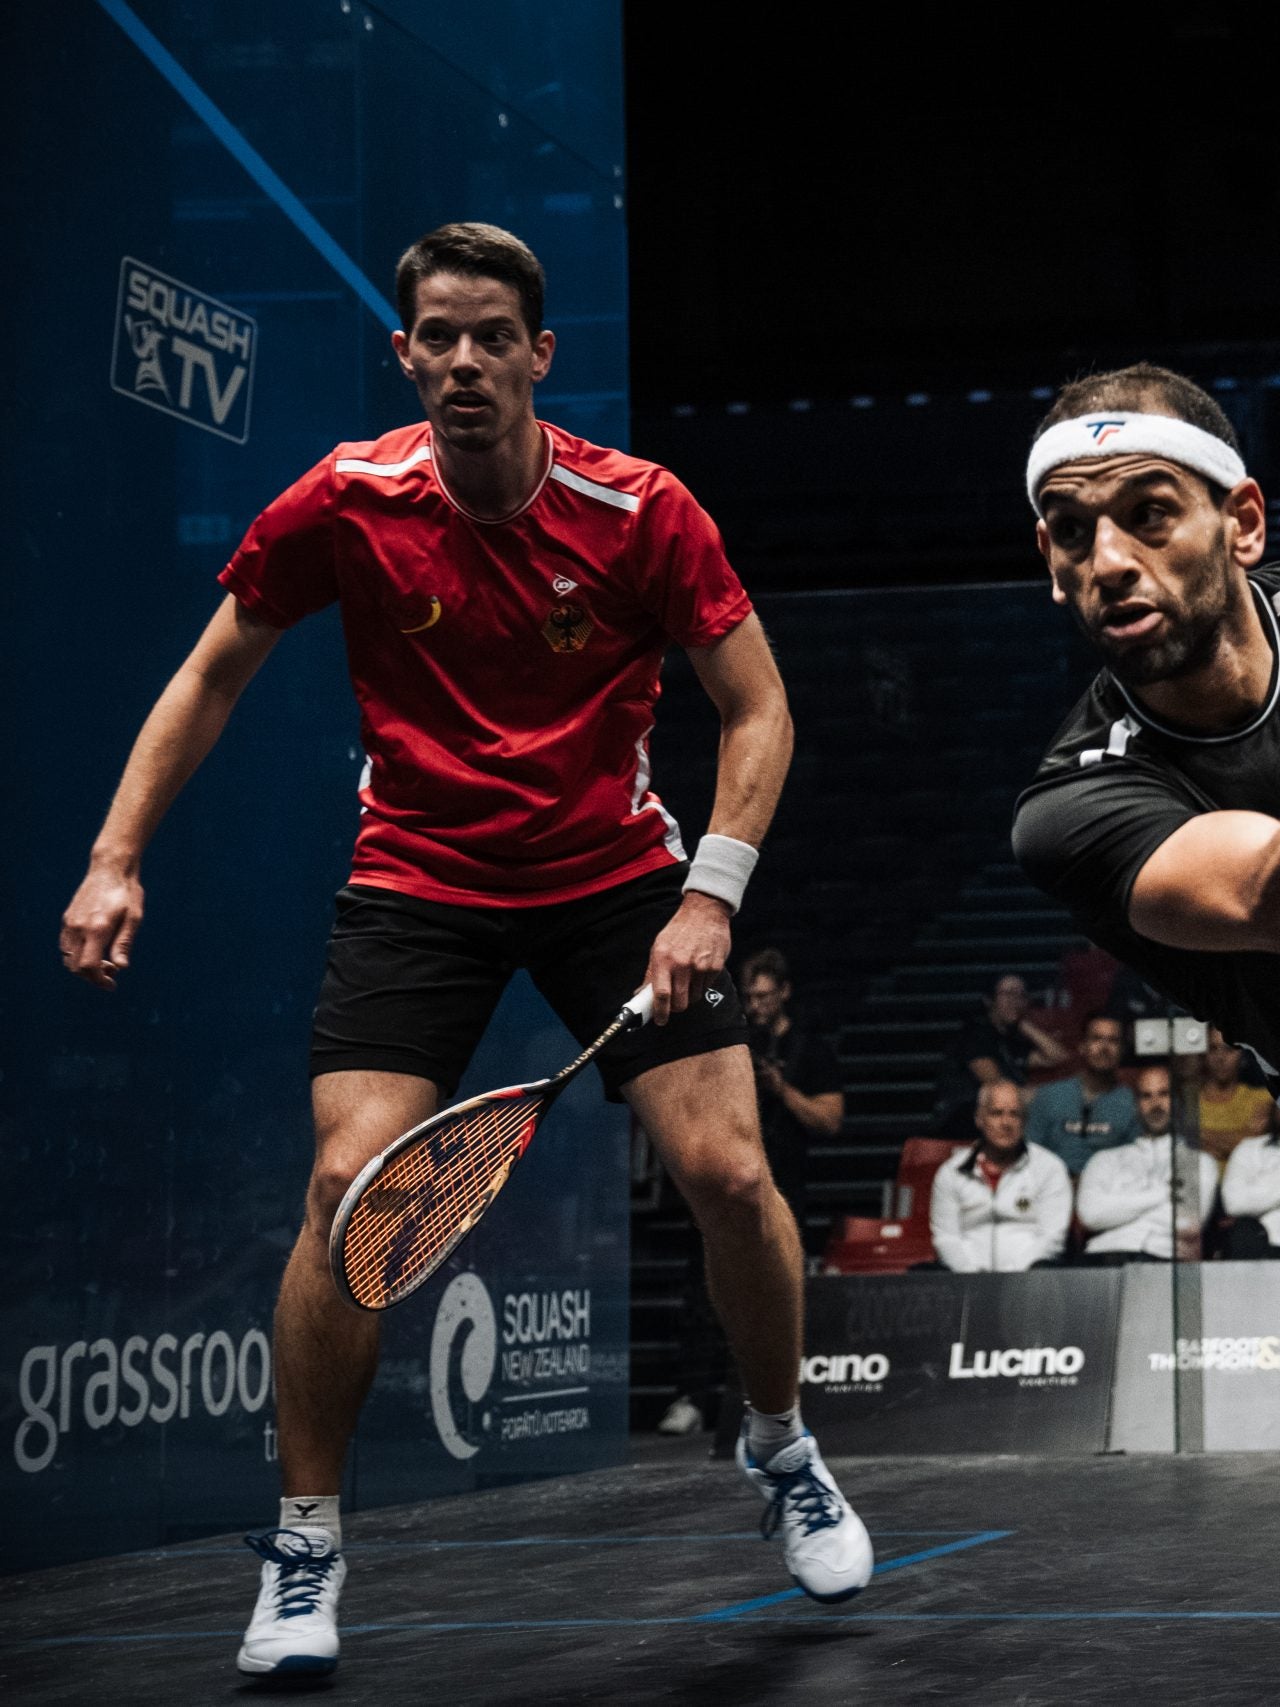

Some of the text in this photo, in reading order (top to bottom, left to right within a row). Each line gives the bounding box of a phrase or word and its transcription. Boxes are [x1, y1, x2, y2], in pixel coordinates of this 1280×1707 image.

[126, 270, 250, 361] SQUASH
[170, 335, 247, 425] TV
[502, 1288, 591, 1345] SQUASH
[502, 1343, 590, 1381] NEW ZEALAND
[798, 1352, 890, 1384] cino
[948, 1342, 1086, 1379] Lucino
[14, 1327, 276, 1473] grassroo
